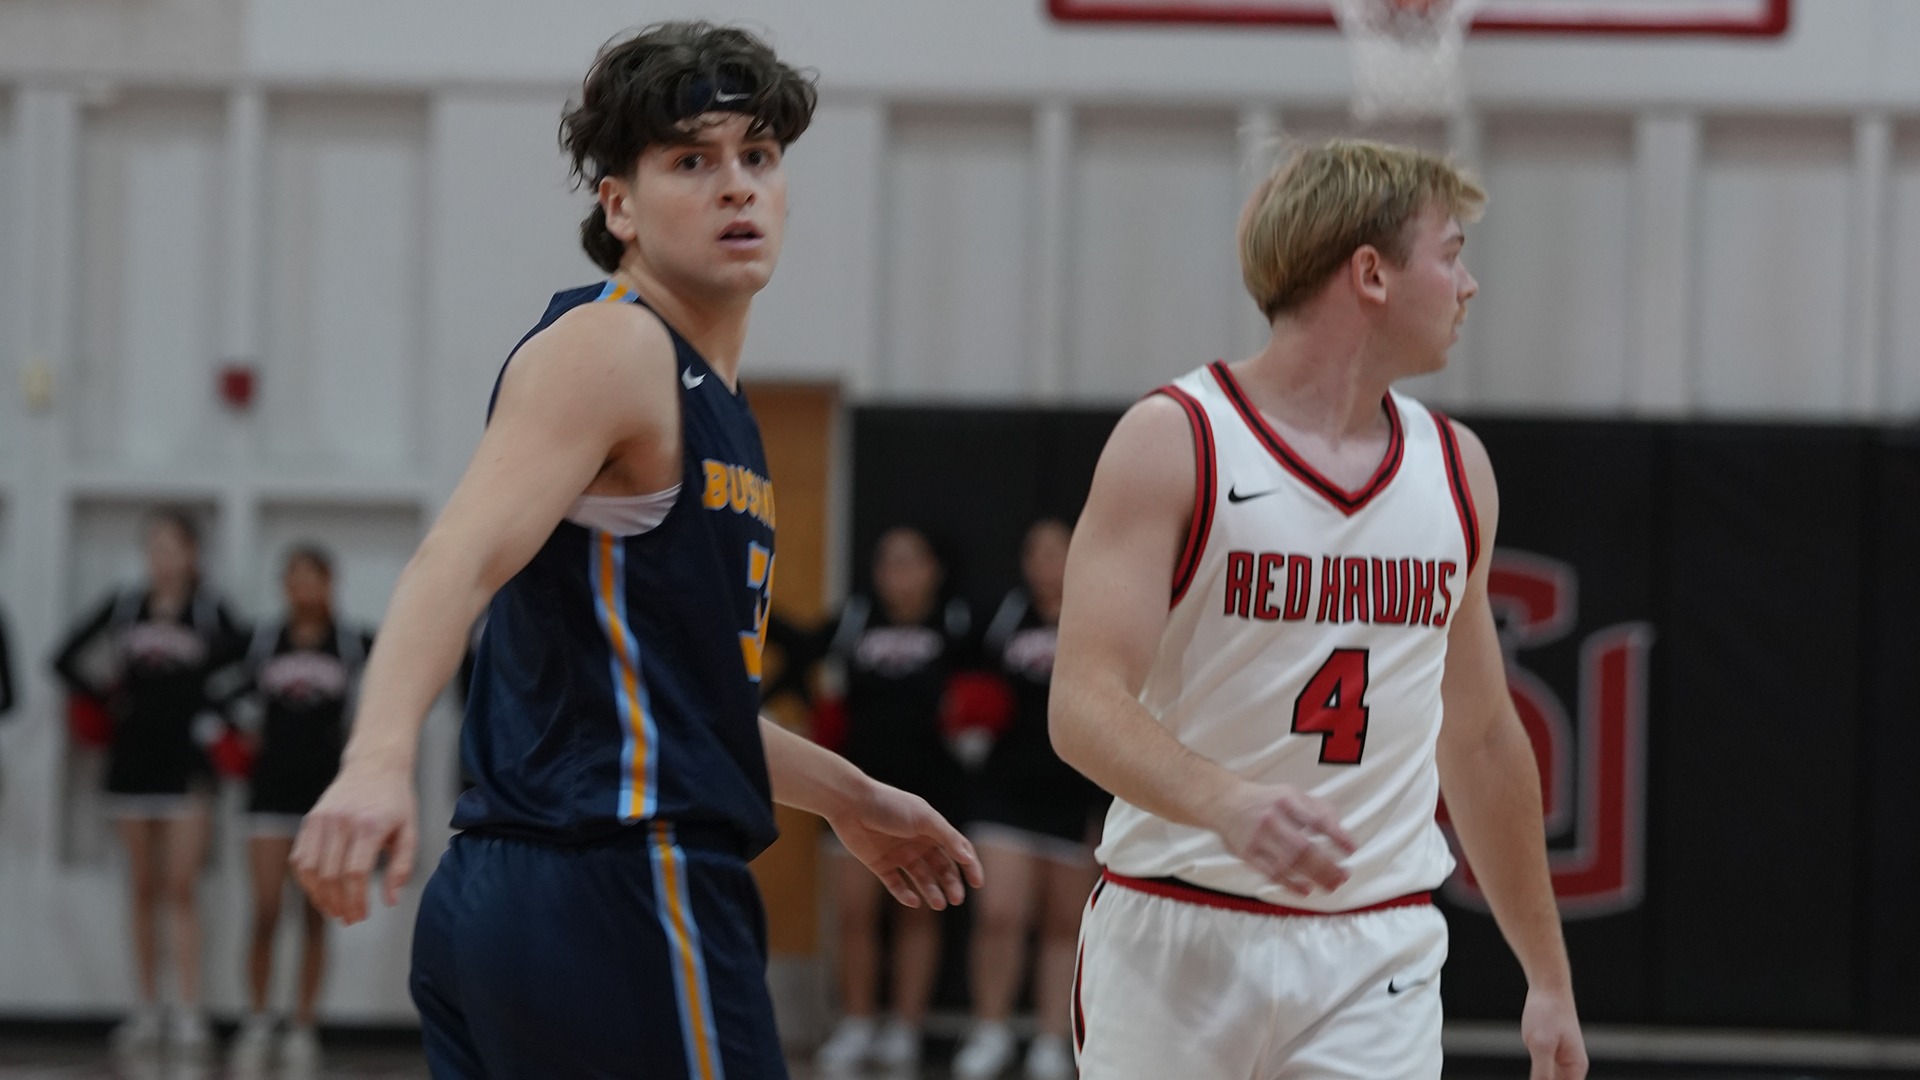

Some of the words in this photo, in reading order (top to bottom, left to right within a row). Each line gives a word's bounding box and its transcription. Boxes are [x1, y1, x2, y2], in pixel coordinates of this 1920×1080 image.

[1224, 551, 1312, 621] RED
[1315, 555, 1457, 627] HAWKS
[1290, 647, 1370, 765] 4
